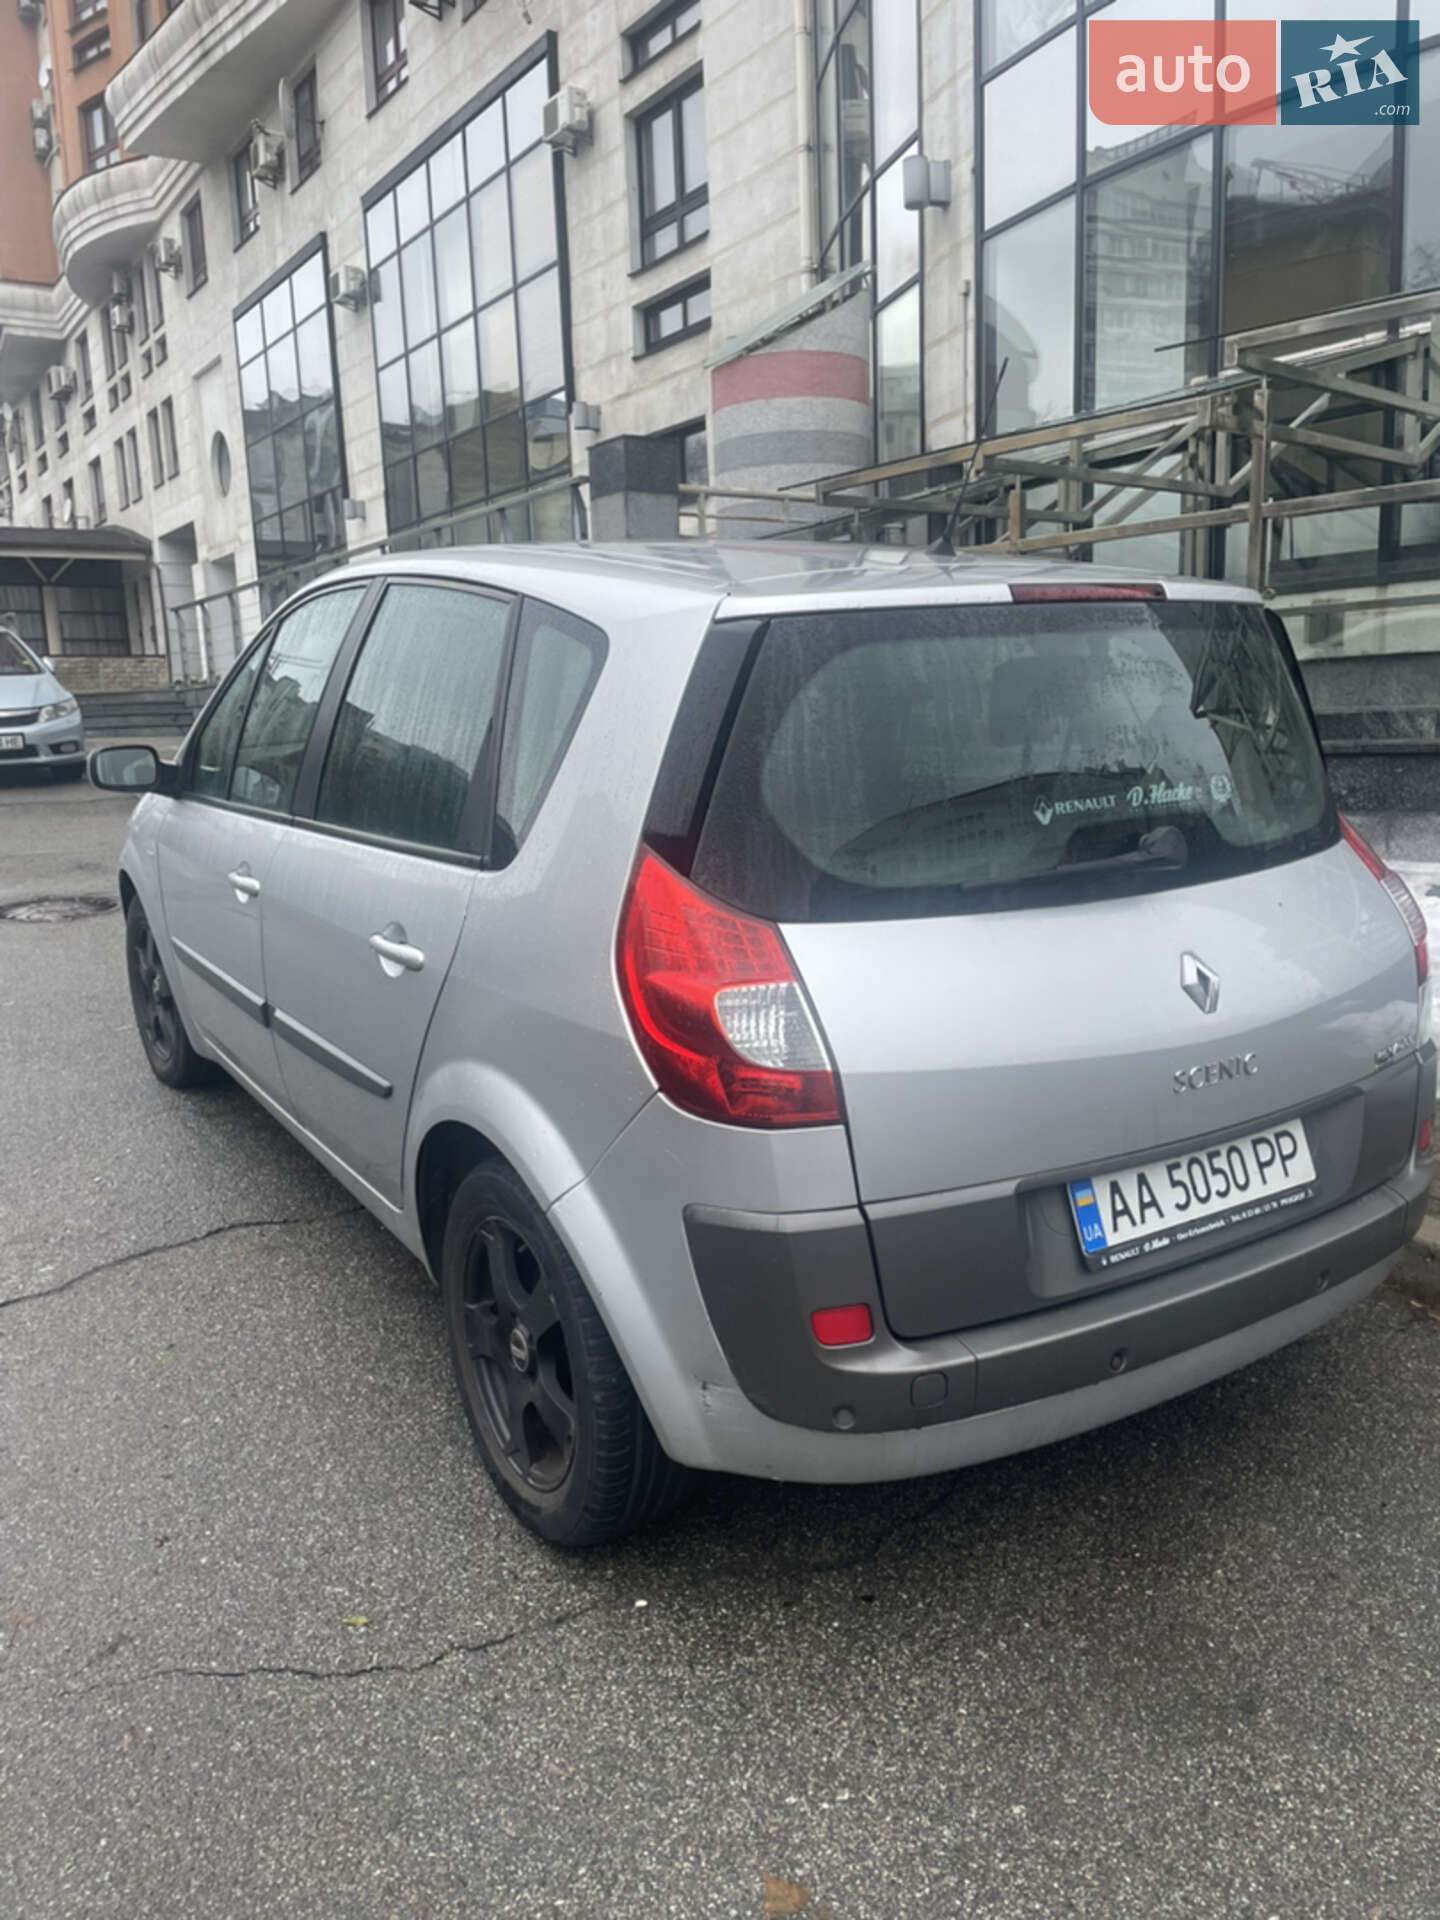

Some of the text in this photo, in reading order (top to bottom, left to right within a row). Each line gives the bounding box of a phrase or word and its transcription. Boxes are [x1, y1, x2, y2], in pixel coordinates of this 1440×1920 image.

[1055, 794, 1117, 816] RENAULT
[1172, 1052, 1259, 1094] SCENIC
[1108, 1130, 1298, 1233] AA 5050 PP
[1083, 1222, 1105, 1243] UA
